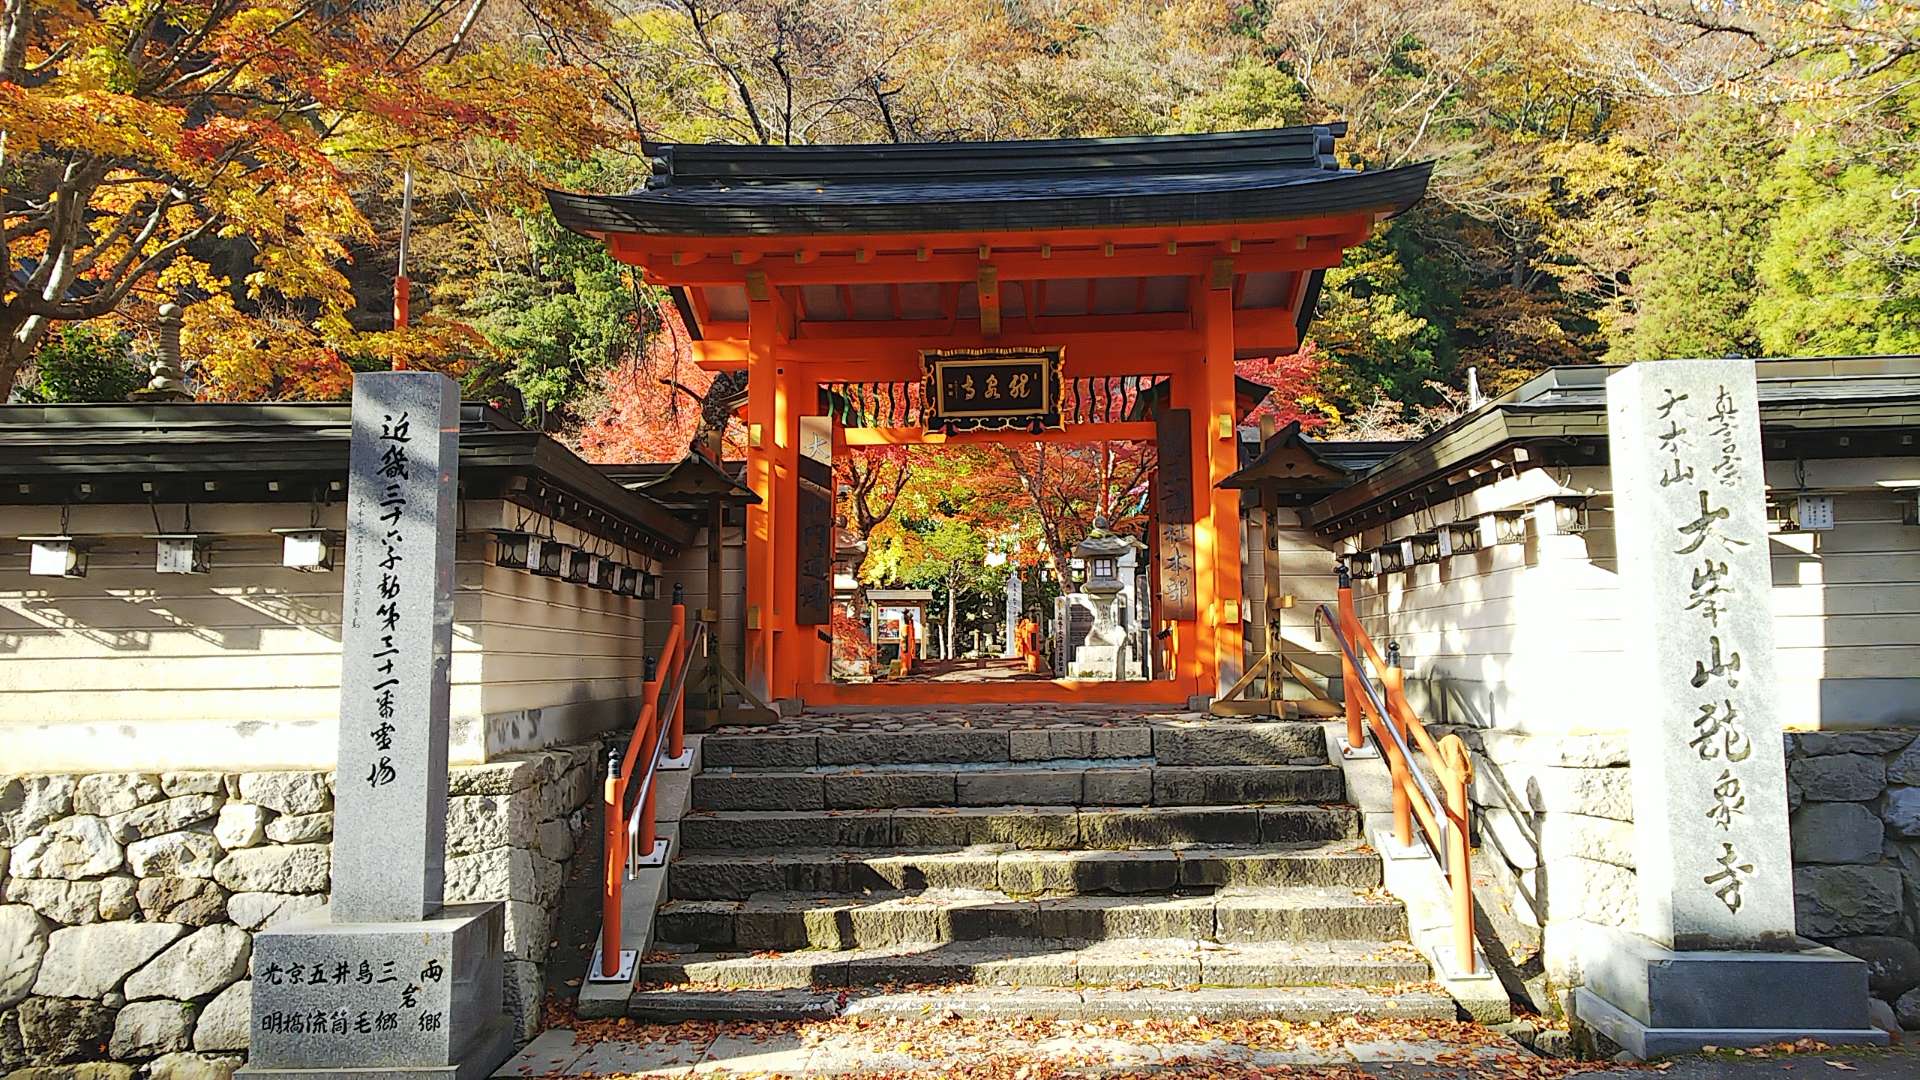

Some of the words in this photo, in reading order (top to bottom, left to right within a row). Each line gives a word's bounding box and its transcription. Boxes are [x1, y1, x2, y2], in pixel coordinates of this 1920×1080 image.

[1657, 388, 1698, 488] 大本山
[1707, 384, 1743, 488] 真言宗
[1675, 490, 1753, 914] 大峯山龍泉寺
